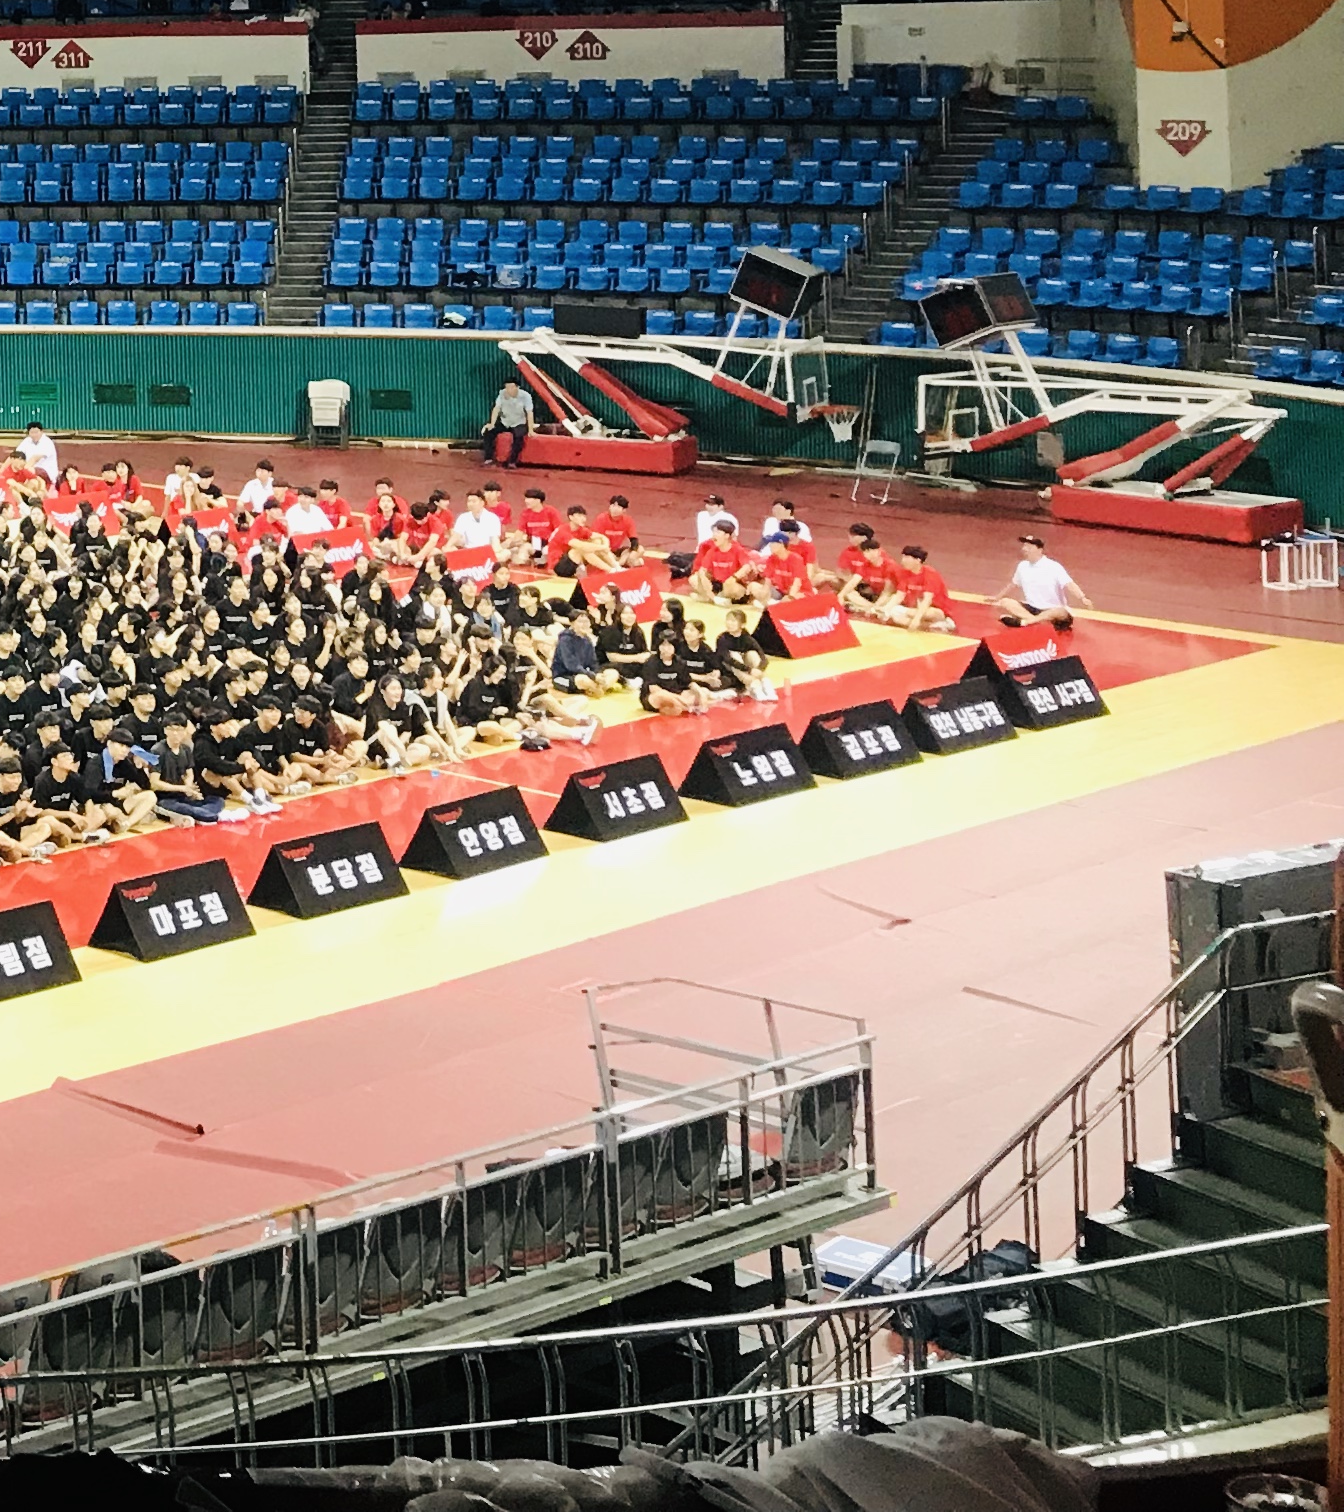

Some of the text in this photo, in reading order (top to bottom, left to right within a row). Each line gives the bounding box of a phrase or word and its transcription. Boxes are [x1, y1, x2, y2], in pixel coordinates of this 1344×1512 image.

[17, 41, 43, 57] 211
[523, 31, 552, 48] 210
[574, 42, 602, 59] 310
[58, 51, 84, 68] 311
[1166, 122, 1202, 141] 209
[838, 724, 902, 761] 김포점
[730, 749, 796, 787] 노원점
[601, 780, 666, 819] 서초점
[457, 814, 527, 858] 안양점
[306, 851, 384, 896] 분당점
[148, 891, 229, 937] 마포점
